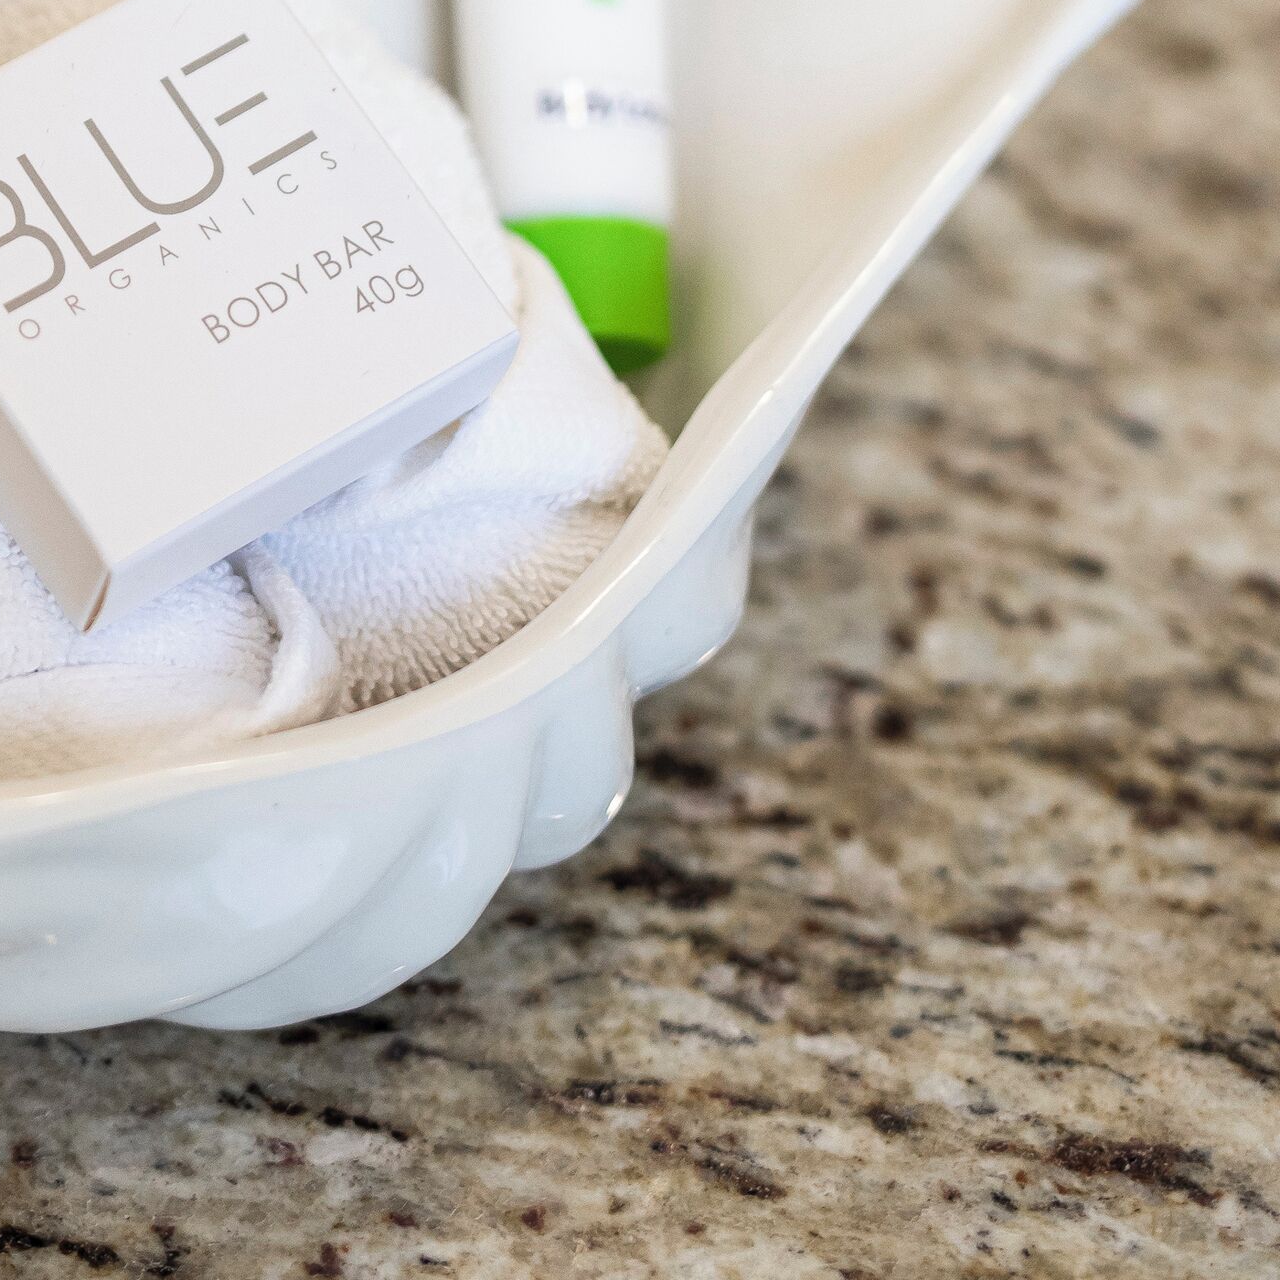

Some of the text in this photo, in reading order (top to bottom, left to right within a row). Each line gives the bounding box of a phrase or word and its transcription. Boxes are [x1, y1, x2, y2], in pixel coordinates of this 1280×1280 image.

[18, 150, 339, 340] ORGANICS
[201, 219, 395, 344] BODY BAR
[354, 264, 425, 314] 40g
